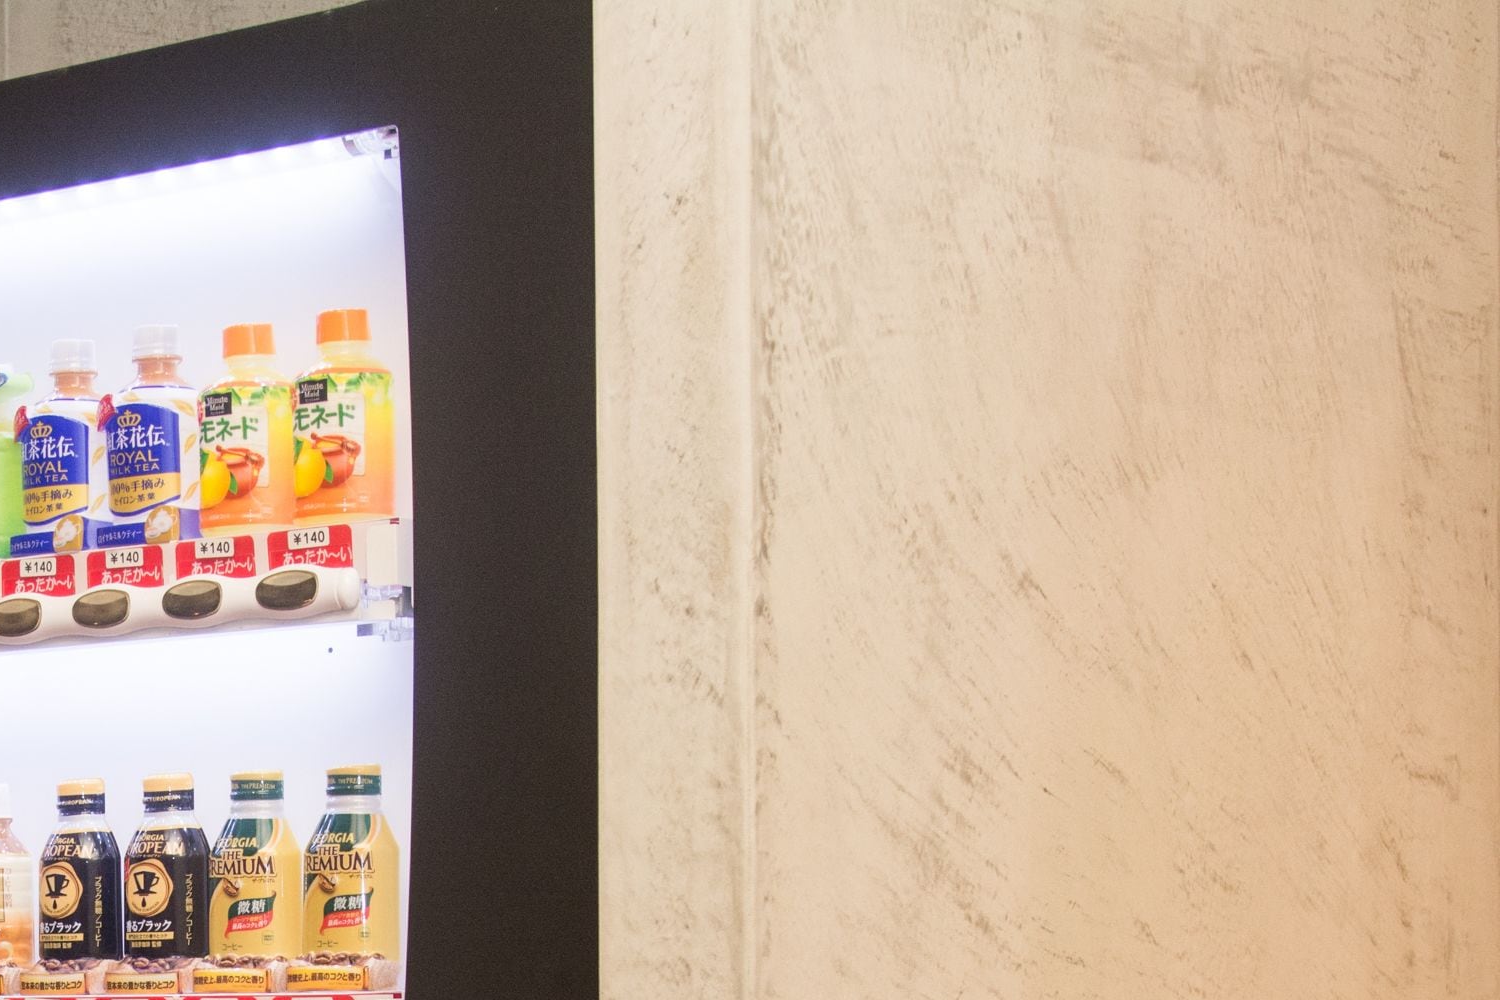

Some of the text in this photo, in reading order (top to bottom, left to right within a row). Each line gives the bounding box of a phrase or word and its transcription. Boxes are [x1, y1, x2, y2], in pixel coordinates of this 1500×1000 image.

[294, 403, 355, 432] モネード
[200, 416, 259, 443] モネード
[110, 450, 160, 466] ROYAL
[134, 462, 160, 472] TEA
[45, 473, 69, 483] TEA
[293, 530, 325, 544] ¥140
[200, 541, 230, 554] ¥140
[110, 551, 139, 563] ¥140
[25, 561, 53, 573] ¥140
[221, 850, 241, 860] THE
[318, 846, 338, 856] THE
[237, 899, 266, 914] 微糖
[333, 895, 363, 909] 微糖
